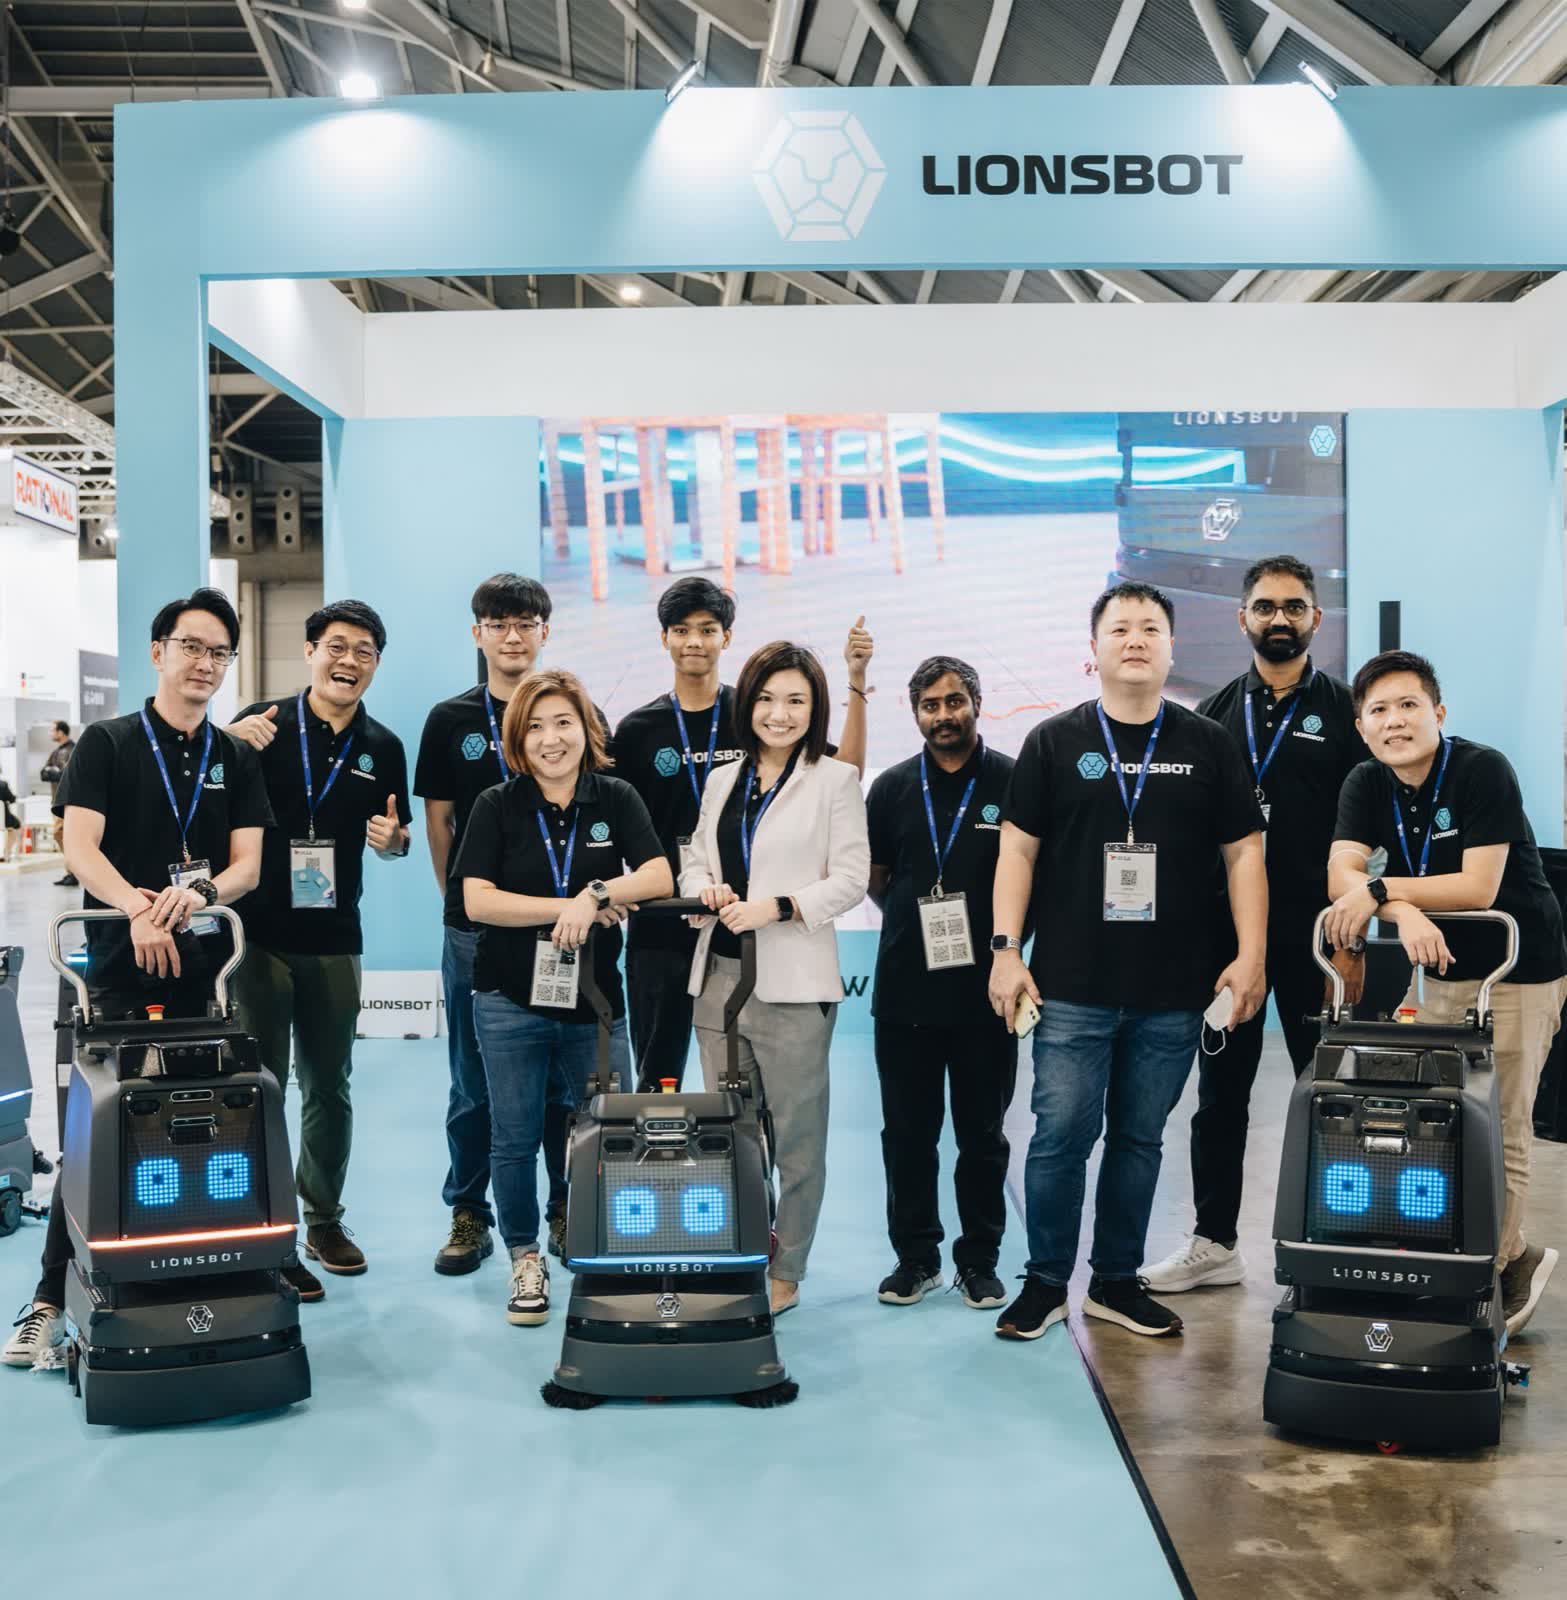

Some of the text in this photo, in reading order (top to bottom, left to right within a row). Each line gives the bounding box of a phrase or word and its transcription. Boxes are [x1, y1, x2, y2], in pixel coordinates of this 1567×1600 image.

[922, 154, 1244, 196] LIONSBOT
[16, 471, 74, 521] RATIONAL
[361, 999, 432, 1011] LIONSBOT
[150, 1251, 244, 1269] LIONSBOT
[624, 1263, 714, 1273] LIONSBOT
[1332, 1267, 1432, 1284] LIONSBOT
